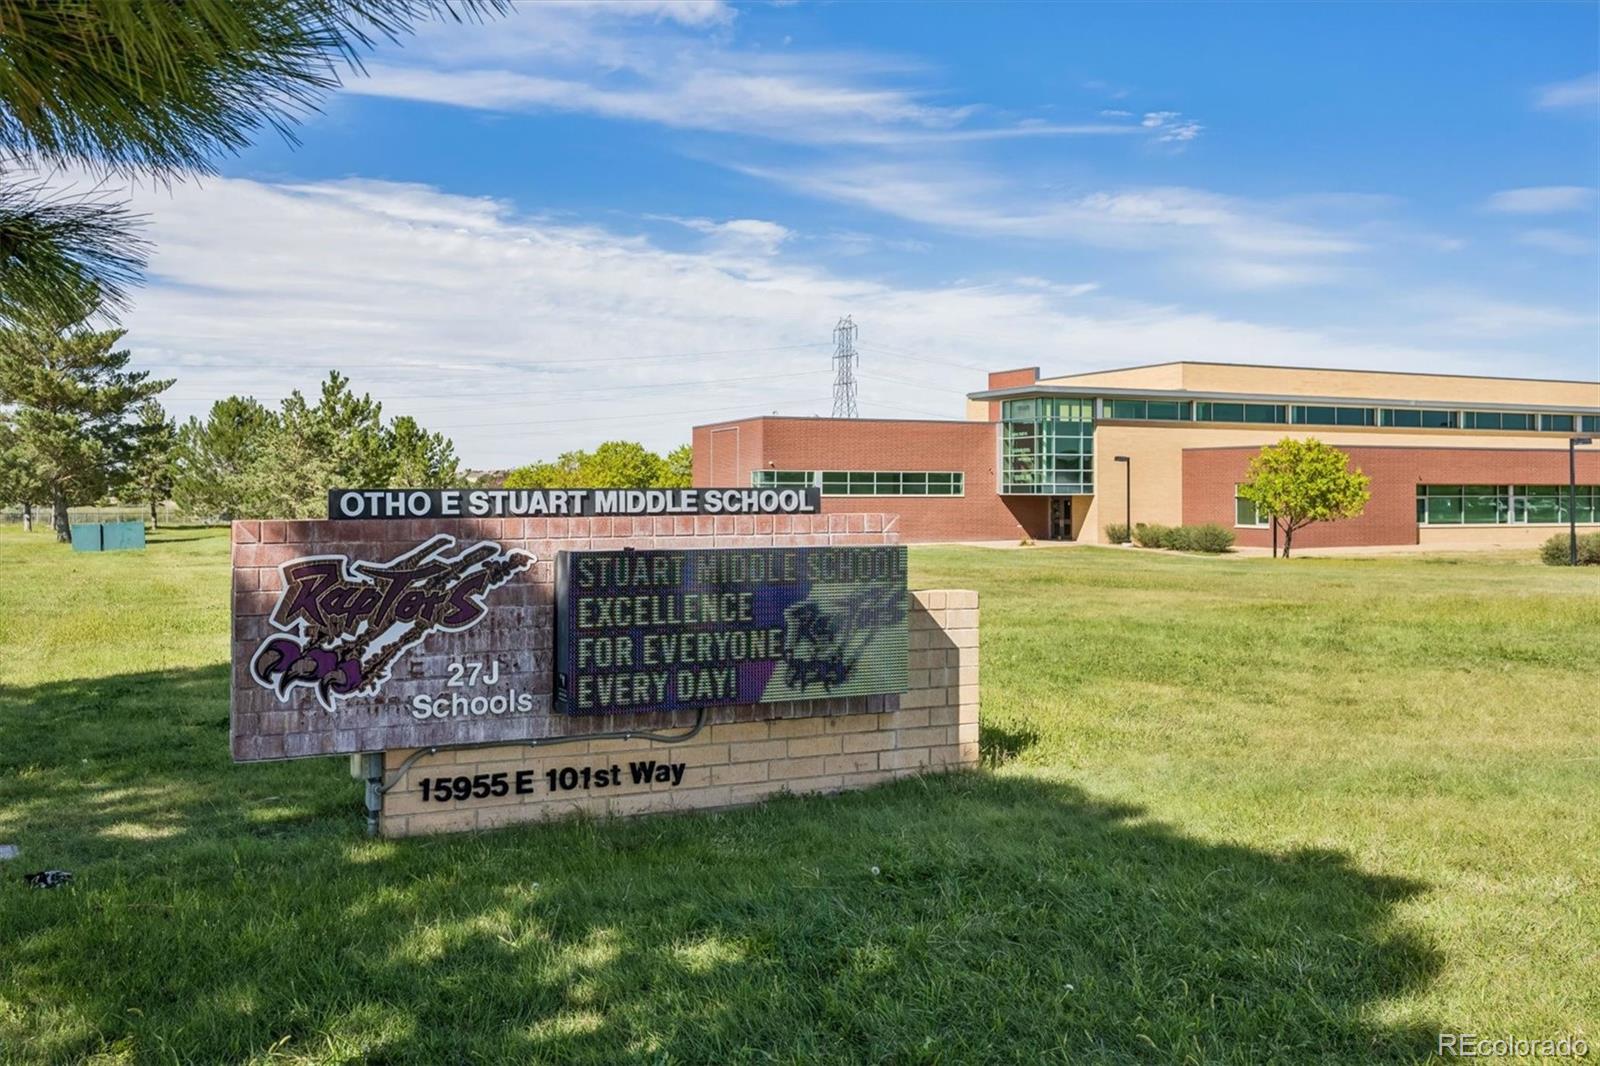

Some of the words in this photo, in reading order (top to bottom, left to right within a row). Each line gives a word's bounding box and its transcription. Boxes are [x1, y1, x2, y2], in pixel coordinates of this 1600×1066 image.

[339, 491, 431, 517] OTHO
[442, 491, 460, 516] E
[468, 490, 587, 516] STUART
[595, 490, 698, 514] MIDDLE
[704, 489, 814, 513] SCHOOL
[578, 555, 685, 588] STUART
[698, 552, 796, 584] MIDDLE
[806, 549, 902, 581] SCHOOL
[578, 592, 753, 629] EXCELLENCE
[578, 636, 633, 669] FOR
[643, 628, 783, 665] EVERYONE
[447, 660, 499, 687] 27J
[578, 672, 668, 709] EVERY
[677, 666, 737, 699] DAY!
[412, 688, 533, 720] Schools
[419, 772, 509, 802] 15955
[516, 770, 534, 795] E
[546, 764, 621, 792] 101st
[629, 760, 686, 786] Way
